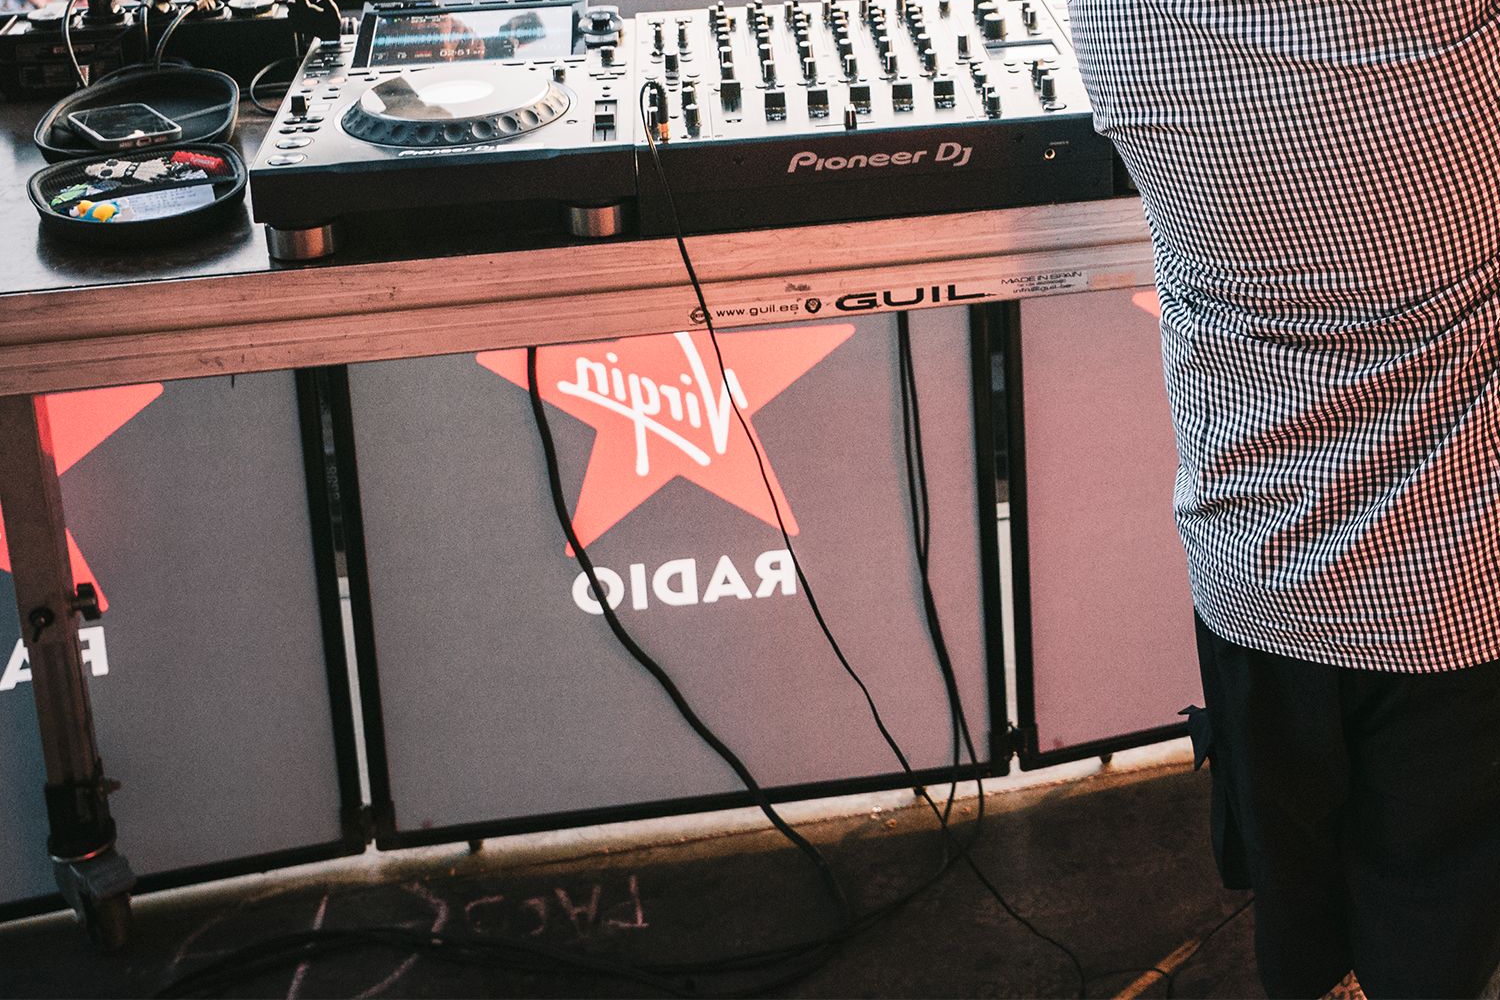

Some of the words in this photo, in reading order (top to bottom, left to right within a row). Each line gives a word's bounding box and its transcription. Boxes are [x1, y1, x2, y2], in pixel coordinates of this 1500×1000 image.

[787, 150, 928, 174] Pioneer
[1001, 276, 1037, 285] MADE
[1050, 271, 1083, 280] SPAIN
[716, 304, 799, 319] www.guil.es
[835, 284, 986, 311] GUIL
